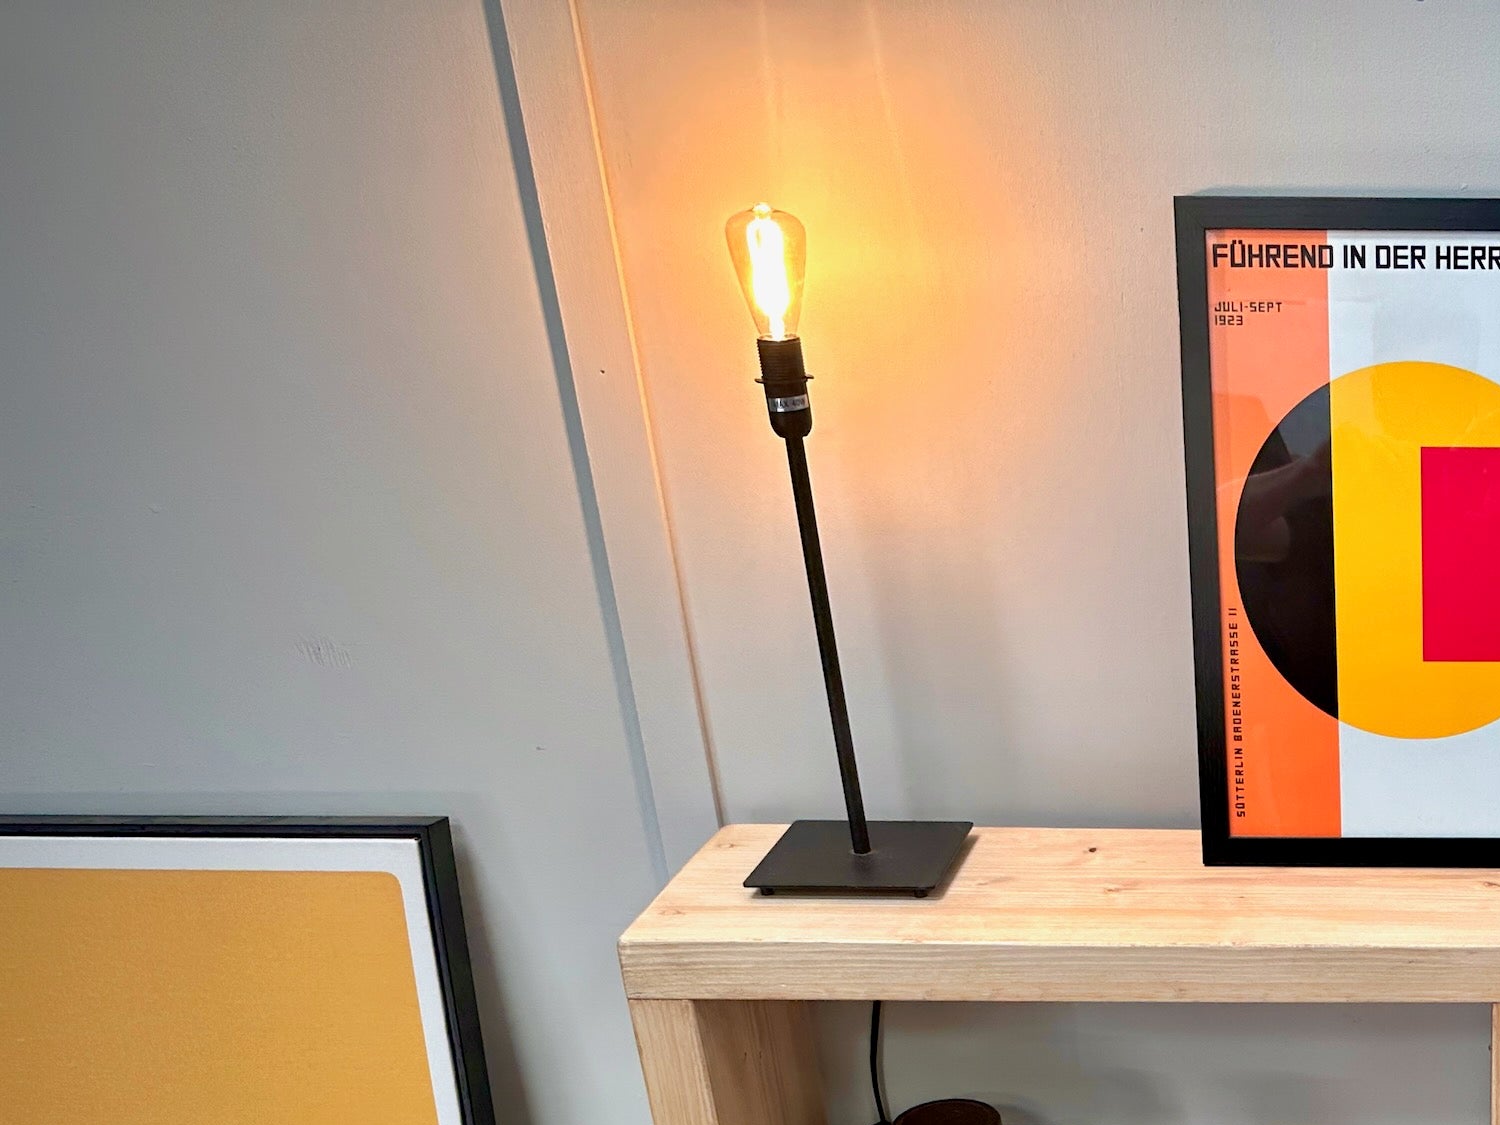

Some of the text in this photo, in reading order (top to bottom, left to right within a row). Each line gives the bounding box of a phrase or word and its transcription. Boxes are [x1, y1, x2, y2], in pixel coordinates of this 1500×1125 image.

[1212, 239, 1334, 268] FÜHREND
[1343, 245, 1366, 269] IN
[1375, 245, 1427, 269] DER
[1214, 301, 1282, 312] JULI-SEPT
[1214, 315, 1243, 326] 1923
